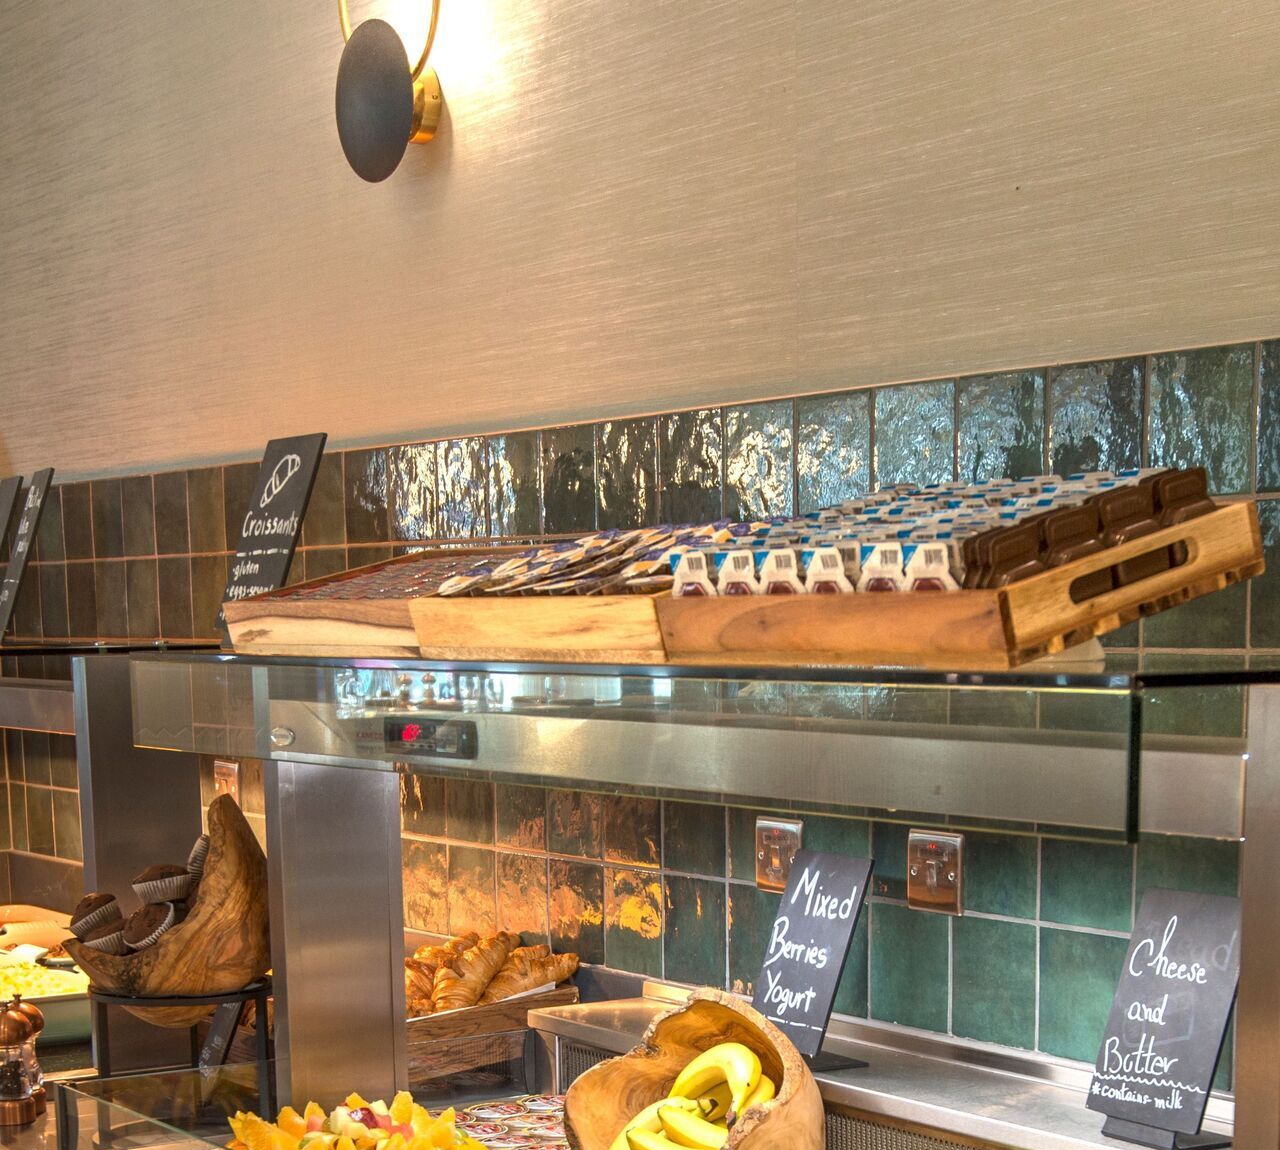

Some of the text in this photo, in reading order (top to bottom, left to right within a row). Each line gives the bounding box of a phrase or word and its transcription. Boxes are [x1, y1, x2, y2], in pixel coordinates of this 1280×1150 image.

[241, 510, 298, 538] Croissants
[790, 867, 857, 920] Mixed
[763, 915, 828, 968] Berries
[1128, 915, 1208, 984] Cheese
[763, 969, 817, 1016] Yogurt
[1127, 993, 1167, 1026] and
[1103, 1033, 1179, 1076] Butter
[1154, 1088, 1183, 1110] milk
